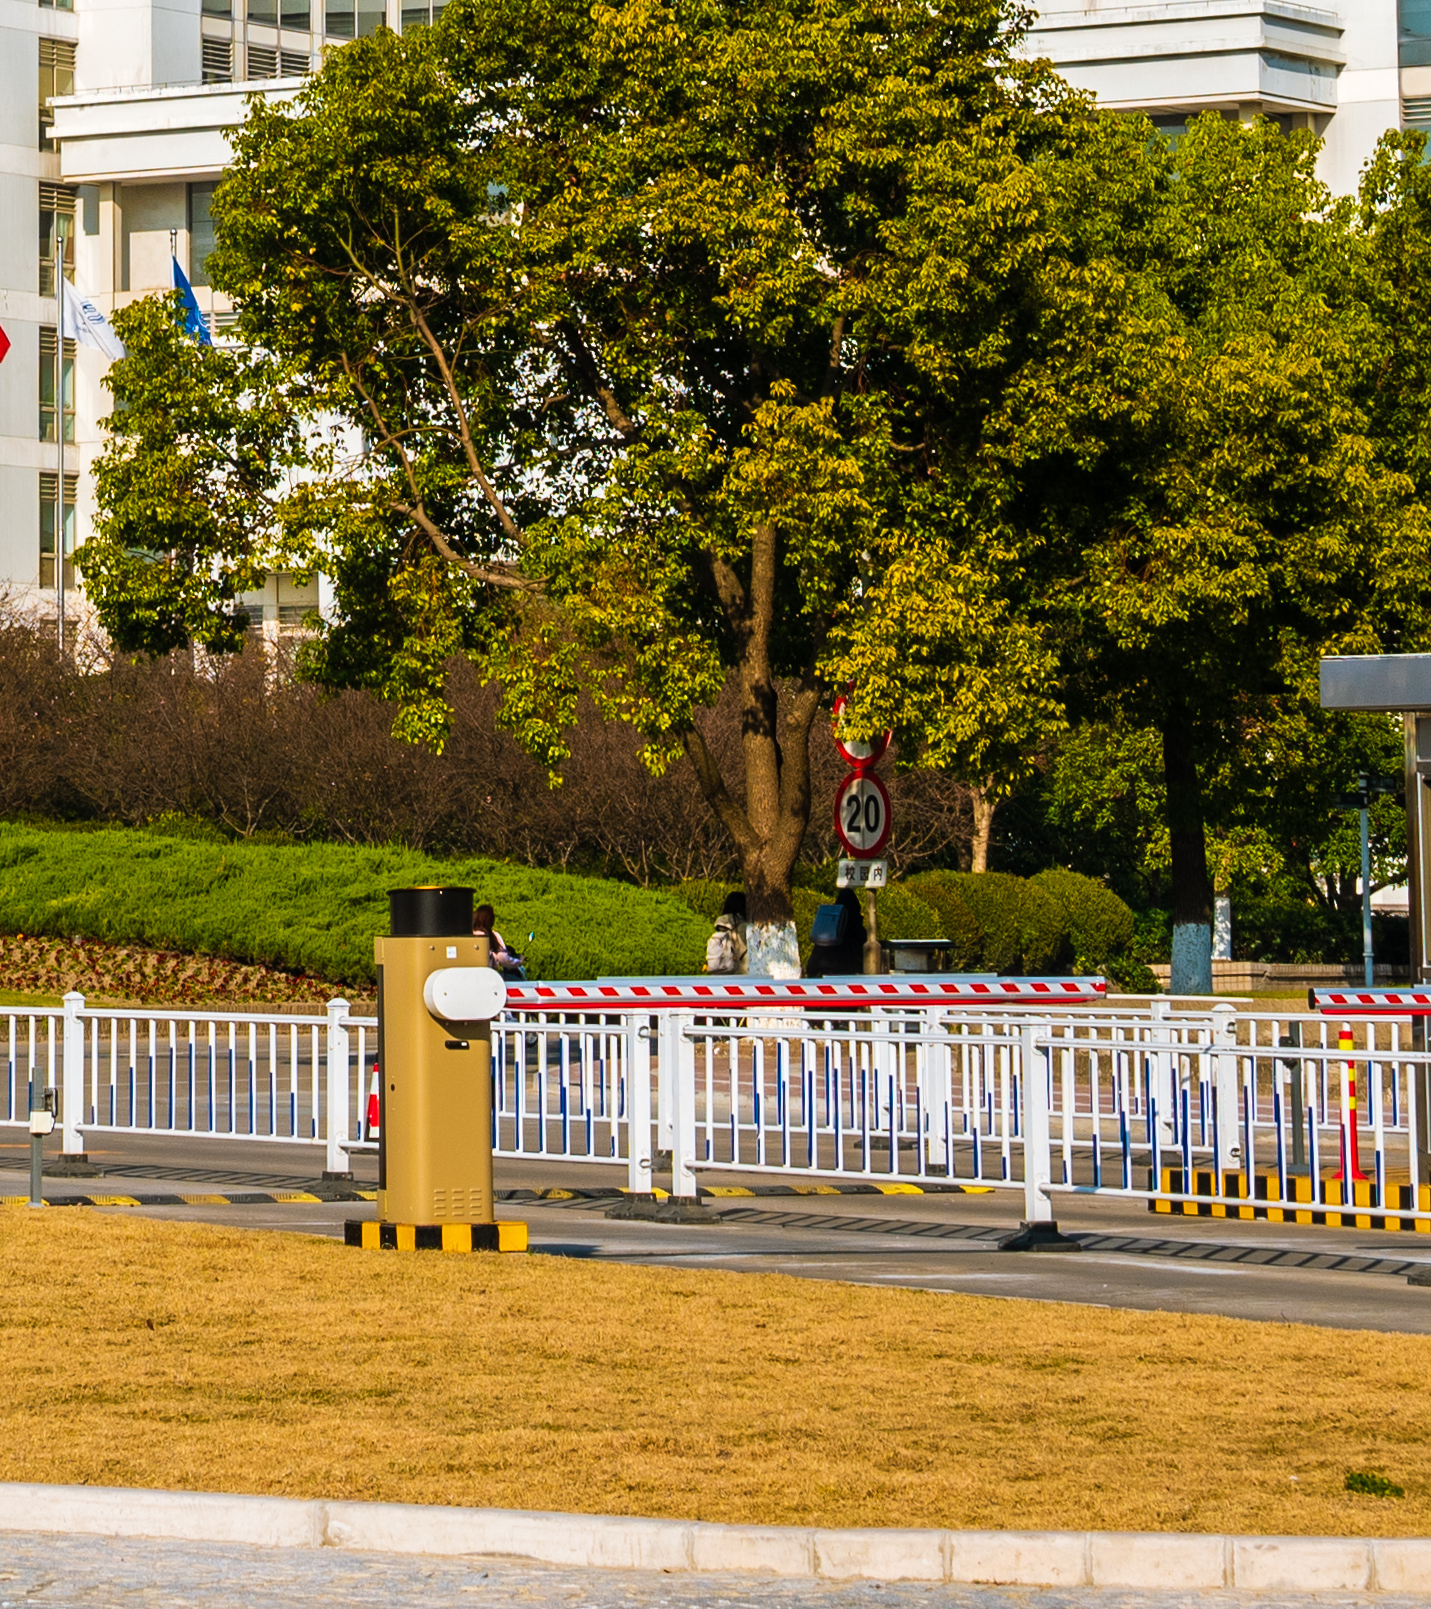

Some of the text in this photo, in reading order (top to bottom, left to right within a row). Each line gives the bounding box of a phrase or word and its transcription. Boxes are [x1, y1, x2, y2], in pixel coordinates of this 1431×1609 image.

[846, 794, 880, 833] 20
[844, 864, 883, 882] 校园内
